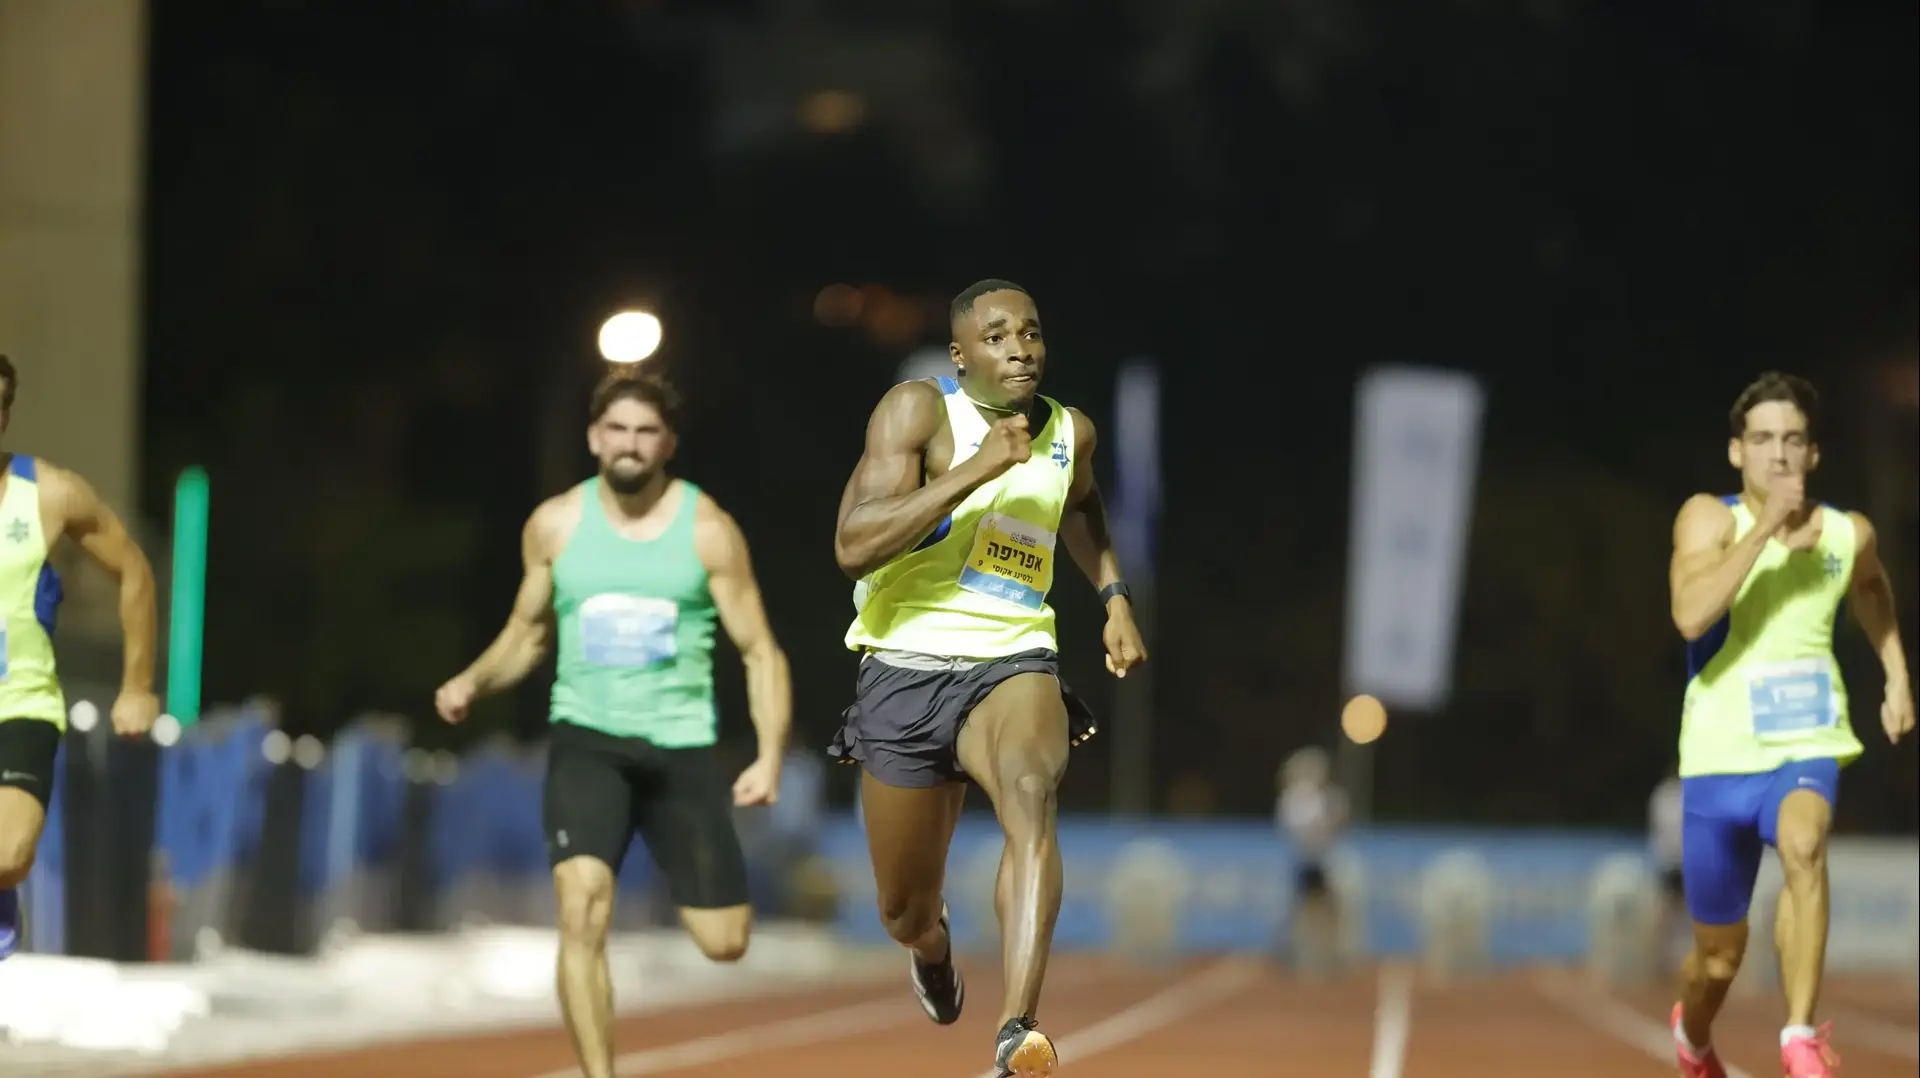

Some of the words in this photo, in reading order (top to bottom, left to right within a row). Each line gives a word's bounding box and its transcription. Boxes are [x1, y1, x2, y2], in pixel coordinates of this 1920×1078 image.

[987, 541, 1043, 572] אפריפה
[978, 559, 984, 567] 9
[992, 564, 1013, 576] אקוסי
